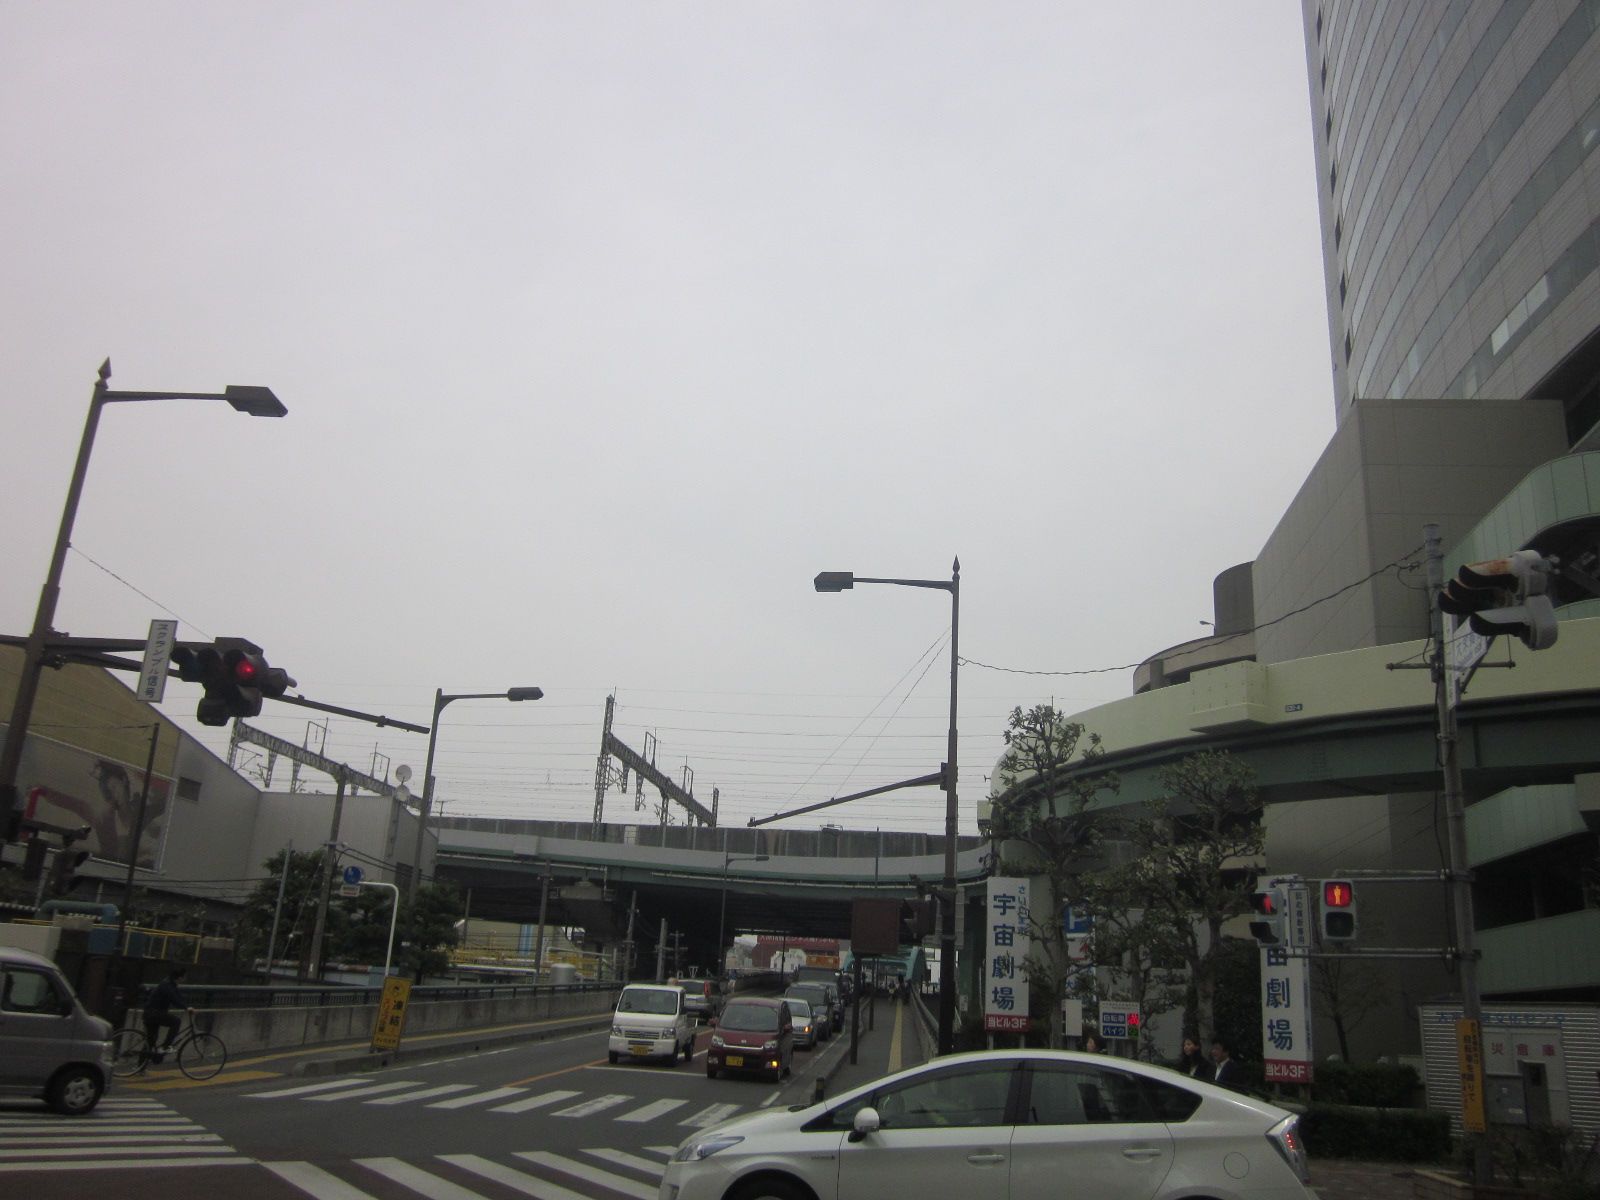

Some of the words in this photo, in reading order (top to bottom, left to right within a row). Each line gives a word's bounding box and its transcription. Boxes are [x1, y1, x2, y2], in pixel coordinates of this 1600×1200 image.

[144, 623, 169, 698] スクランブル信号
[991, 893, 1016, 1011] 宇宙劇場
[987, 1016, 1027, 1029] 当ビル3F
[1266, 1062, 1306, 1078] 当ビル3F
